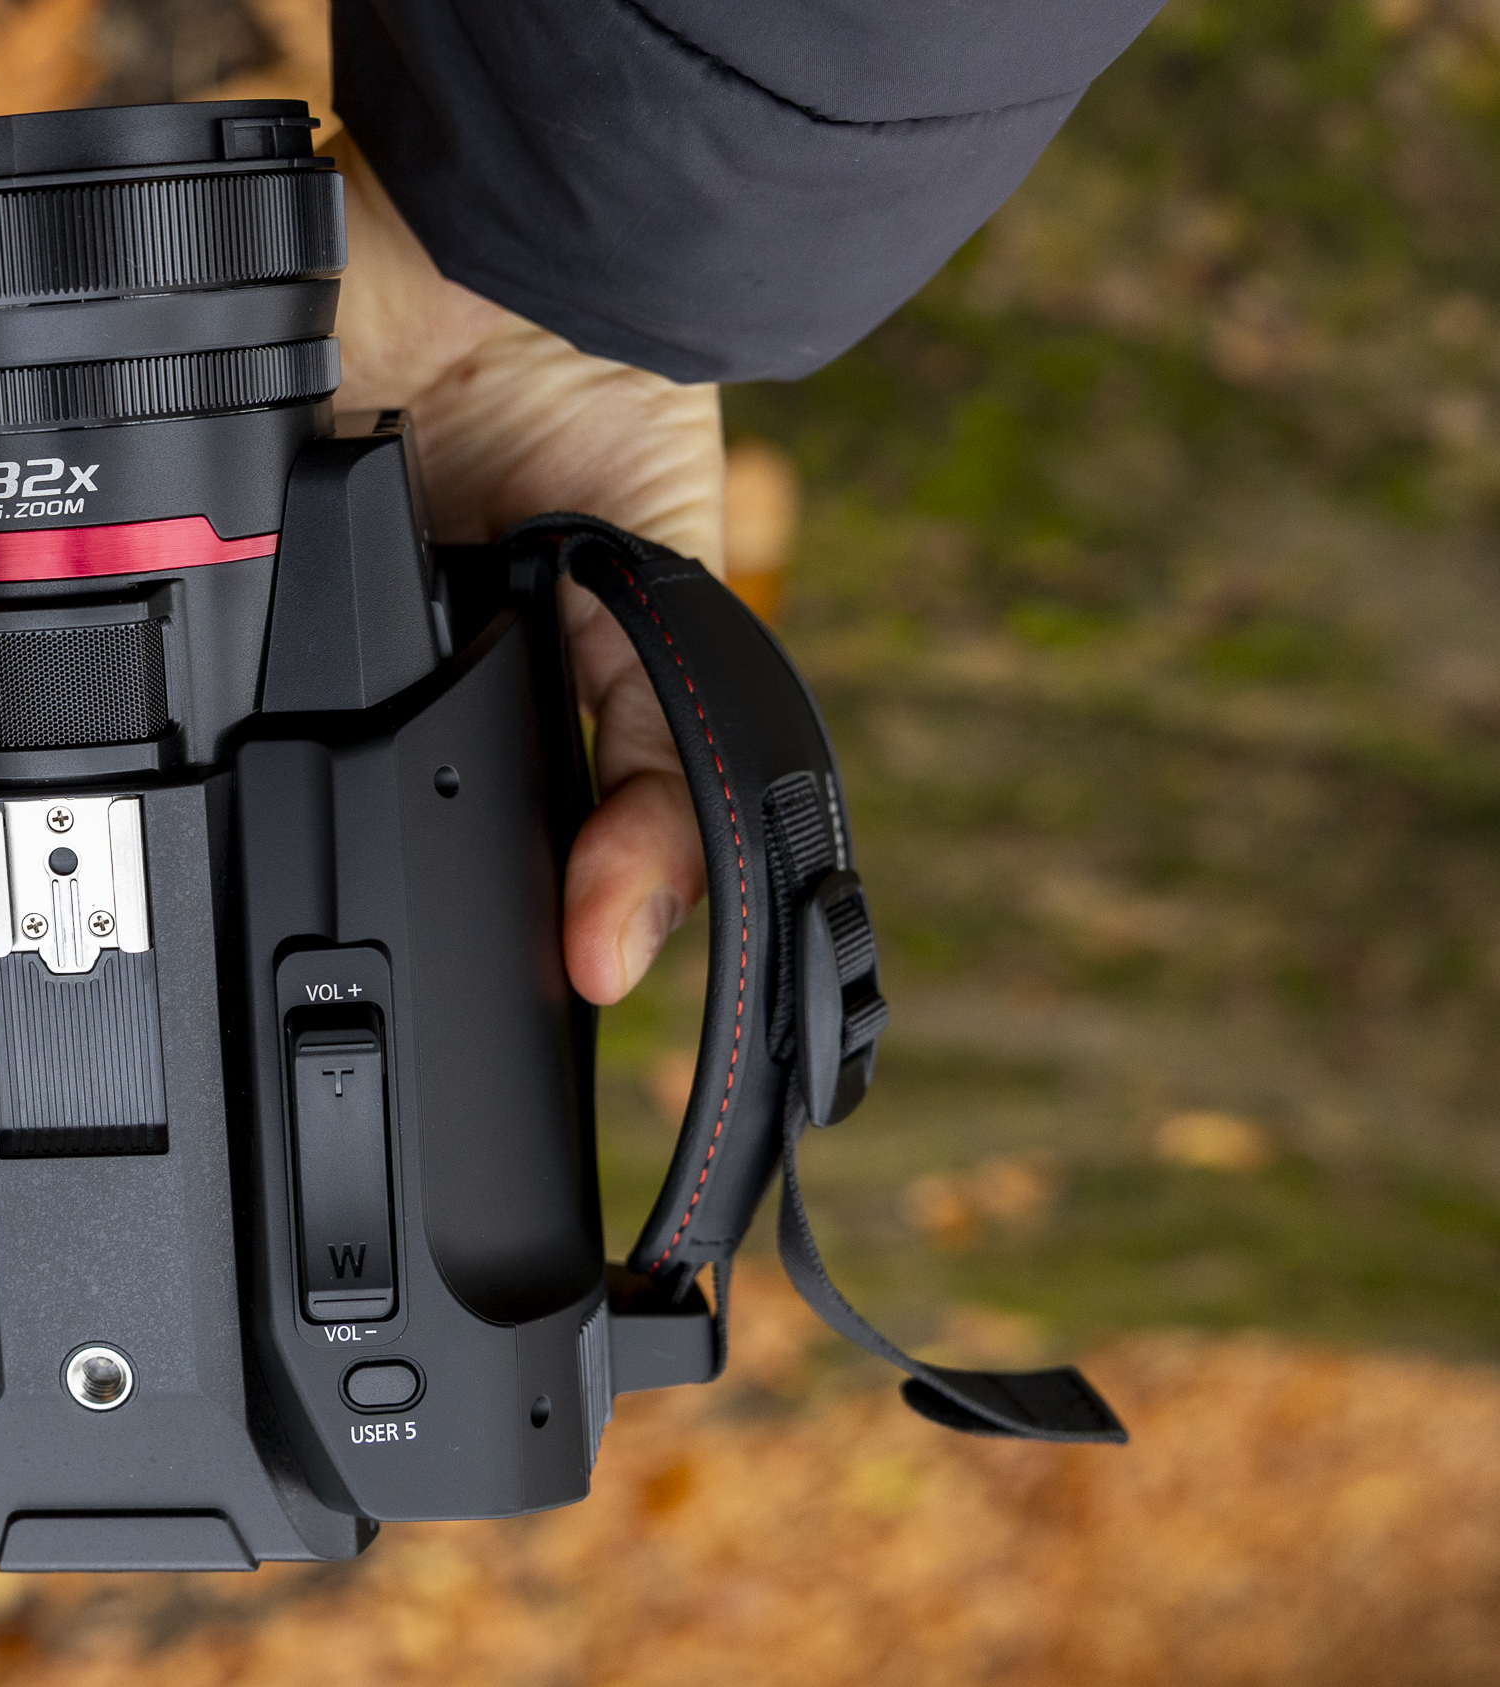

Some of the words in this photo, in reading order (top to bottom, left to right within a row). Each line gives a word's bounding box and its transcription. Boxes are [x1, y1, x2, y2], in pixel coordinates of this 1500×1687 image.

[305, 983, 343, 1001] VOL
[322, 1067, 354, 1097] T
[328, 1242, 366, 1279] W
[324, 1325, 361, 1342] VOL
[350, 1422, 399, 1444] USER
[404, 1421, 417, 1440] 5
